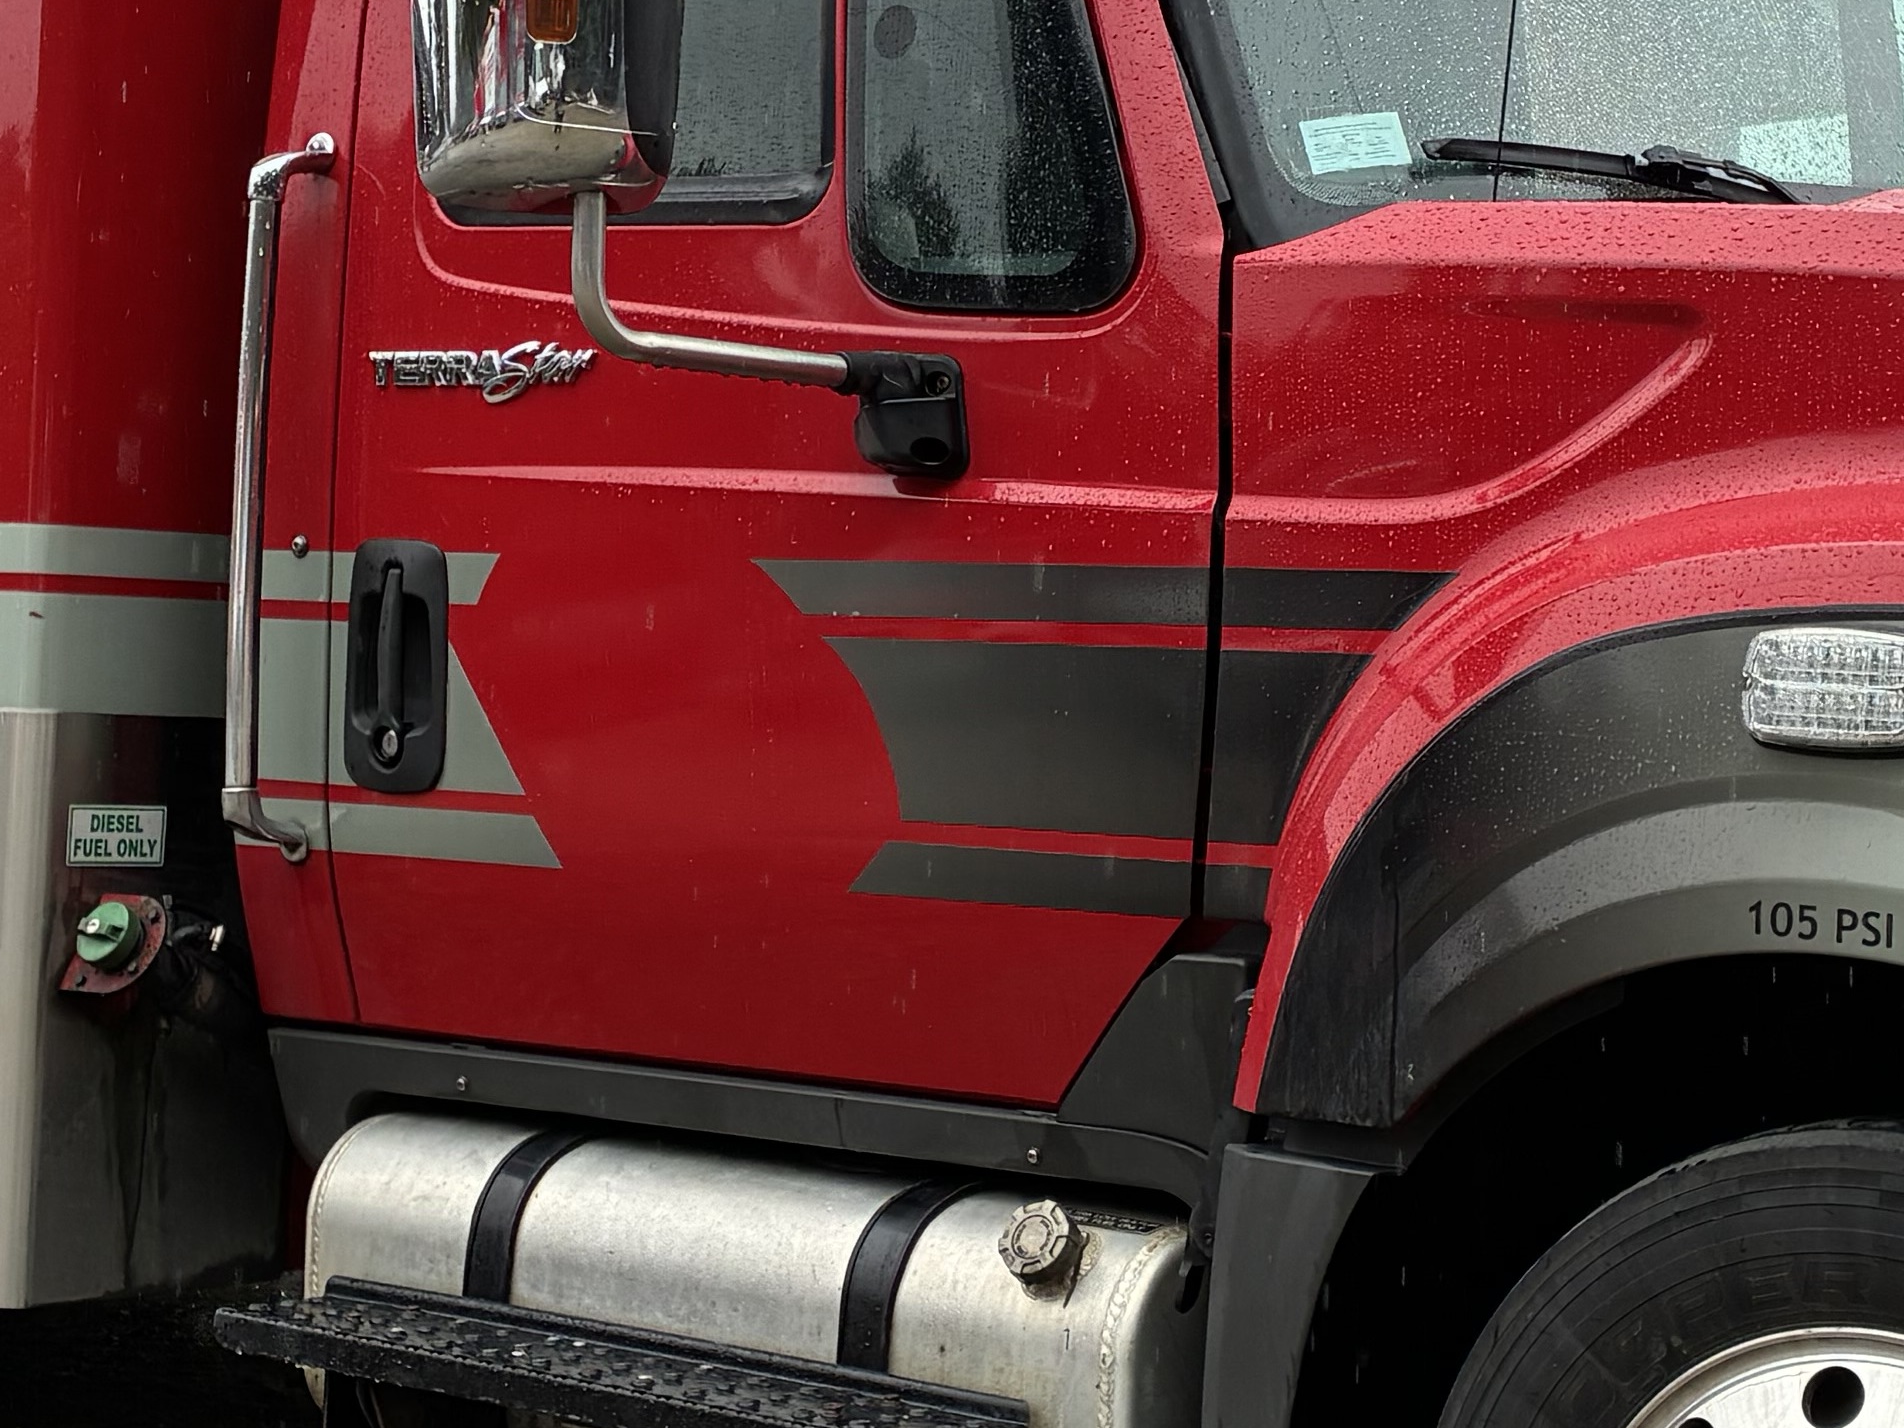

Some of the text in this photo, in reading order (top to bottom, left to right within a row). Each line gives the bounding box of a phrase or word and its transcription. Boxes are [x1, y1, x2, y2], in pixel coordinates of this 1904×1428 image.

[89, 813, 144, 833] DIESEL
[73, 838, 158, 859] FUEL ONLY
[1748, 899, 1894, 949] 105 PSI
